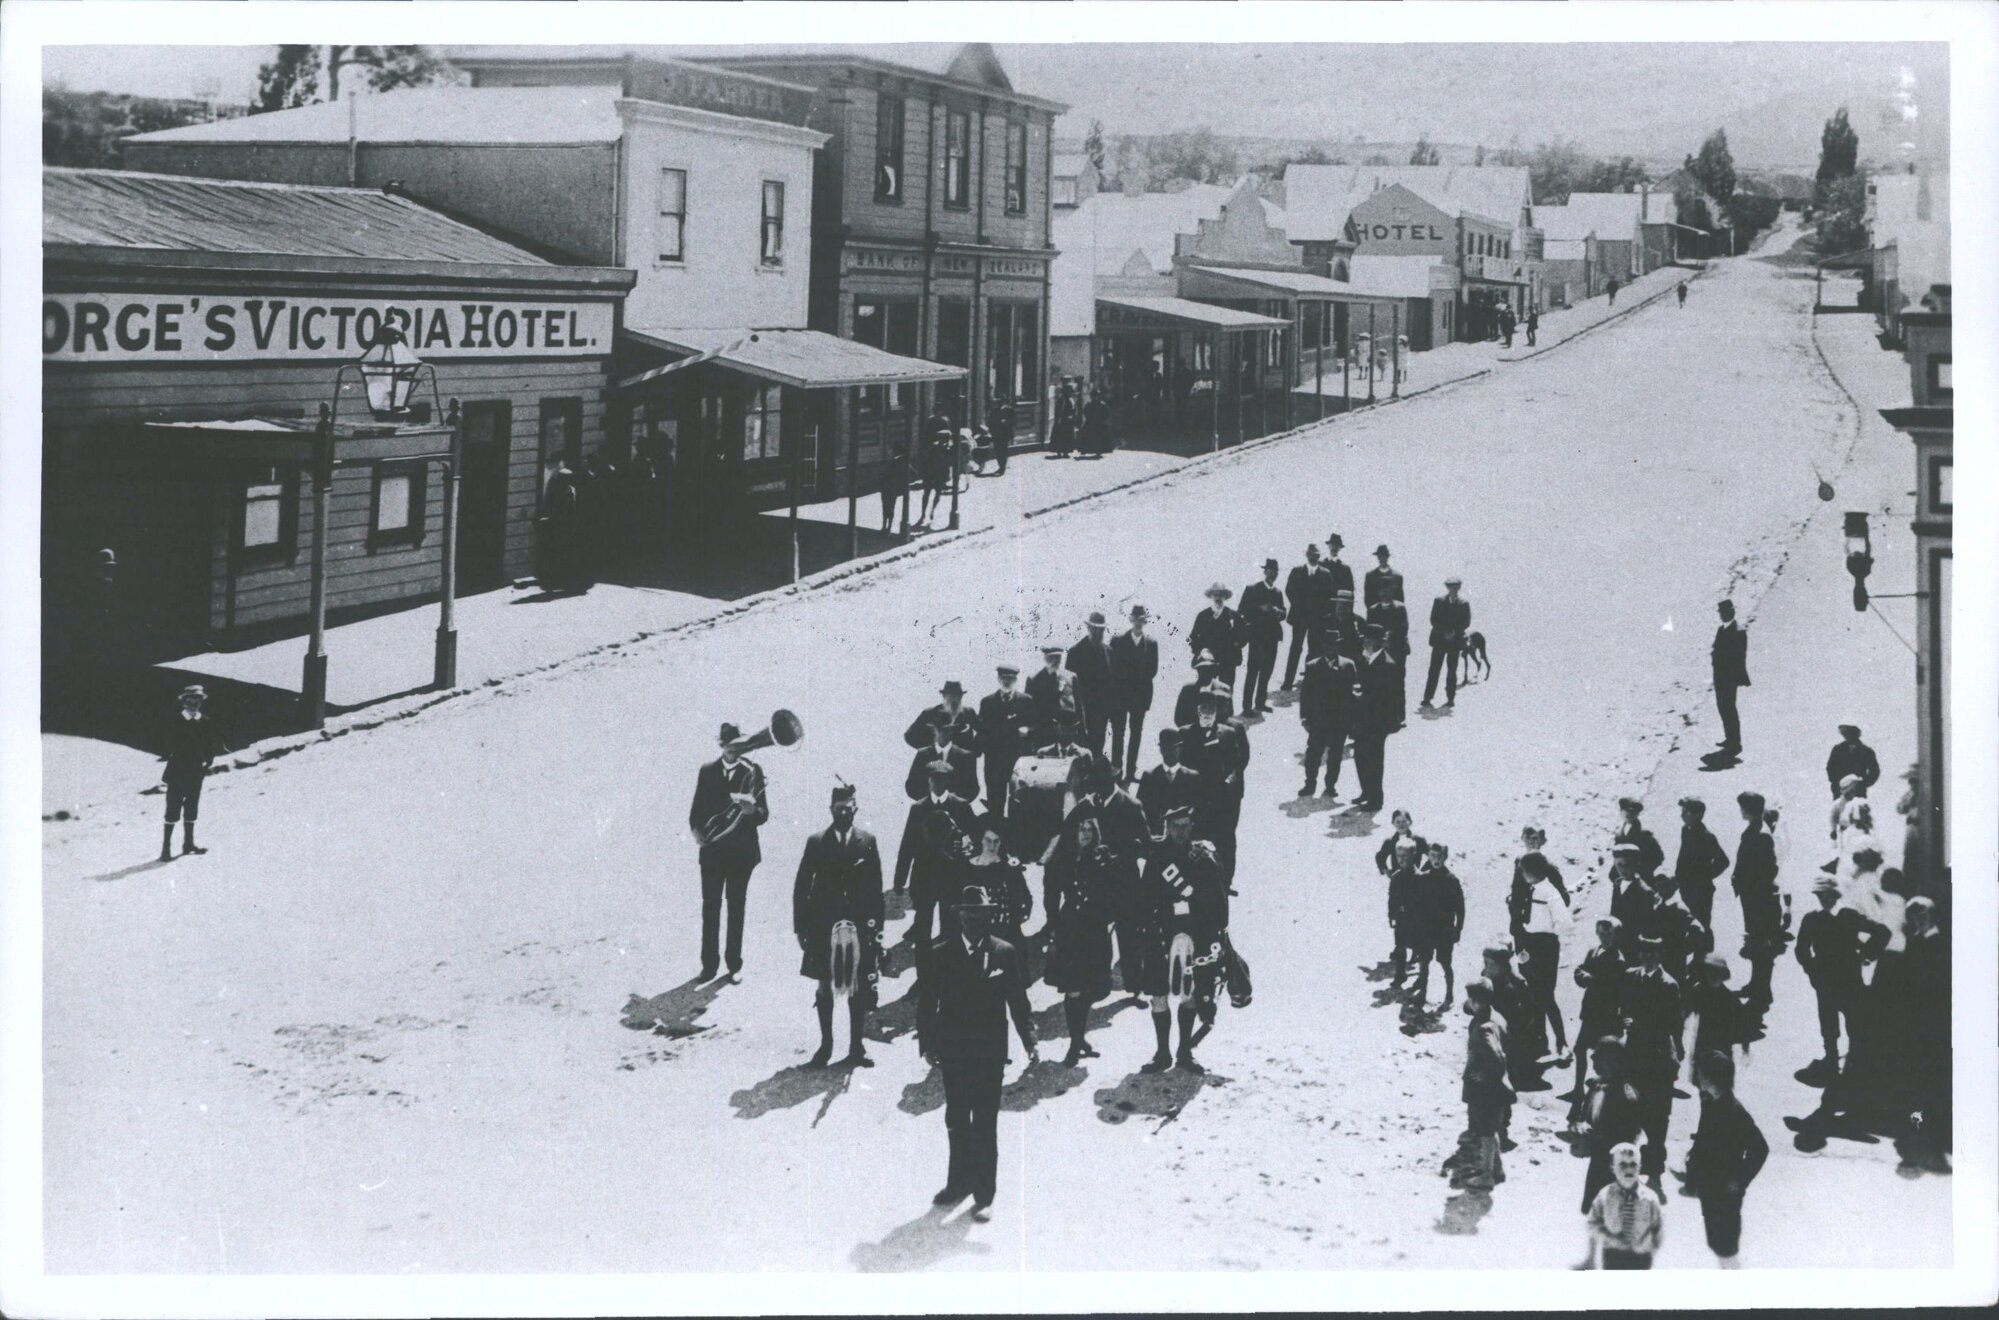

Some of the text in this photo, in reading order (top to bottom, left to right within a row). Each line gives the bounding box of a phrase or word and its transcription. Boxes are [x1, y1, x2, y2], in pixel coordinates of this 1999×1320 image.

[1357, 223, 1443, 240] HOTEL
[42, 298, 596, 354] ORGE'S VICTORIA HOTEL.
